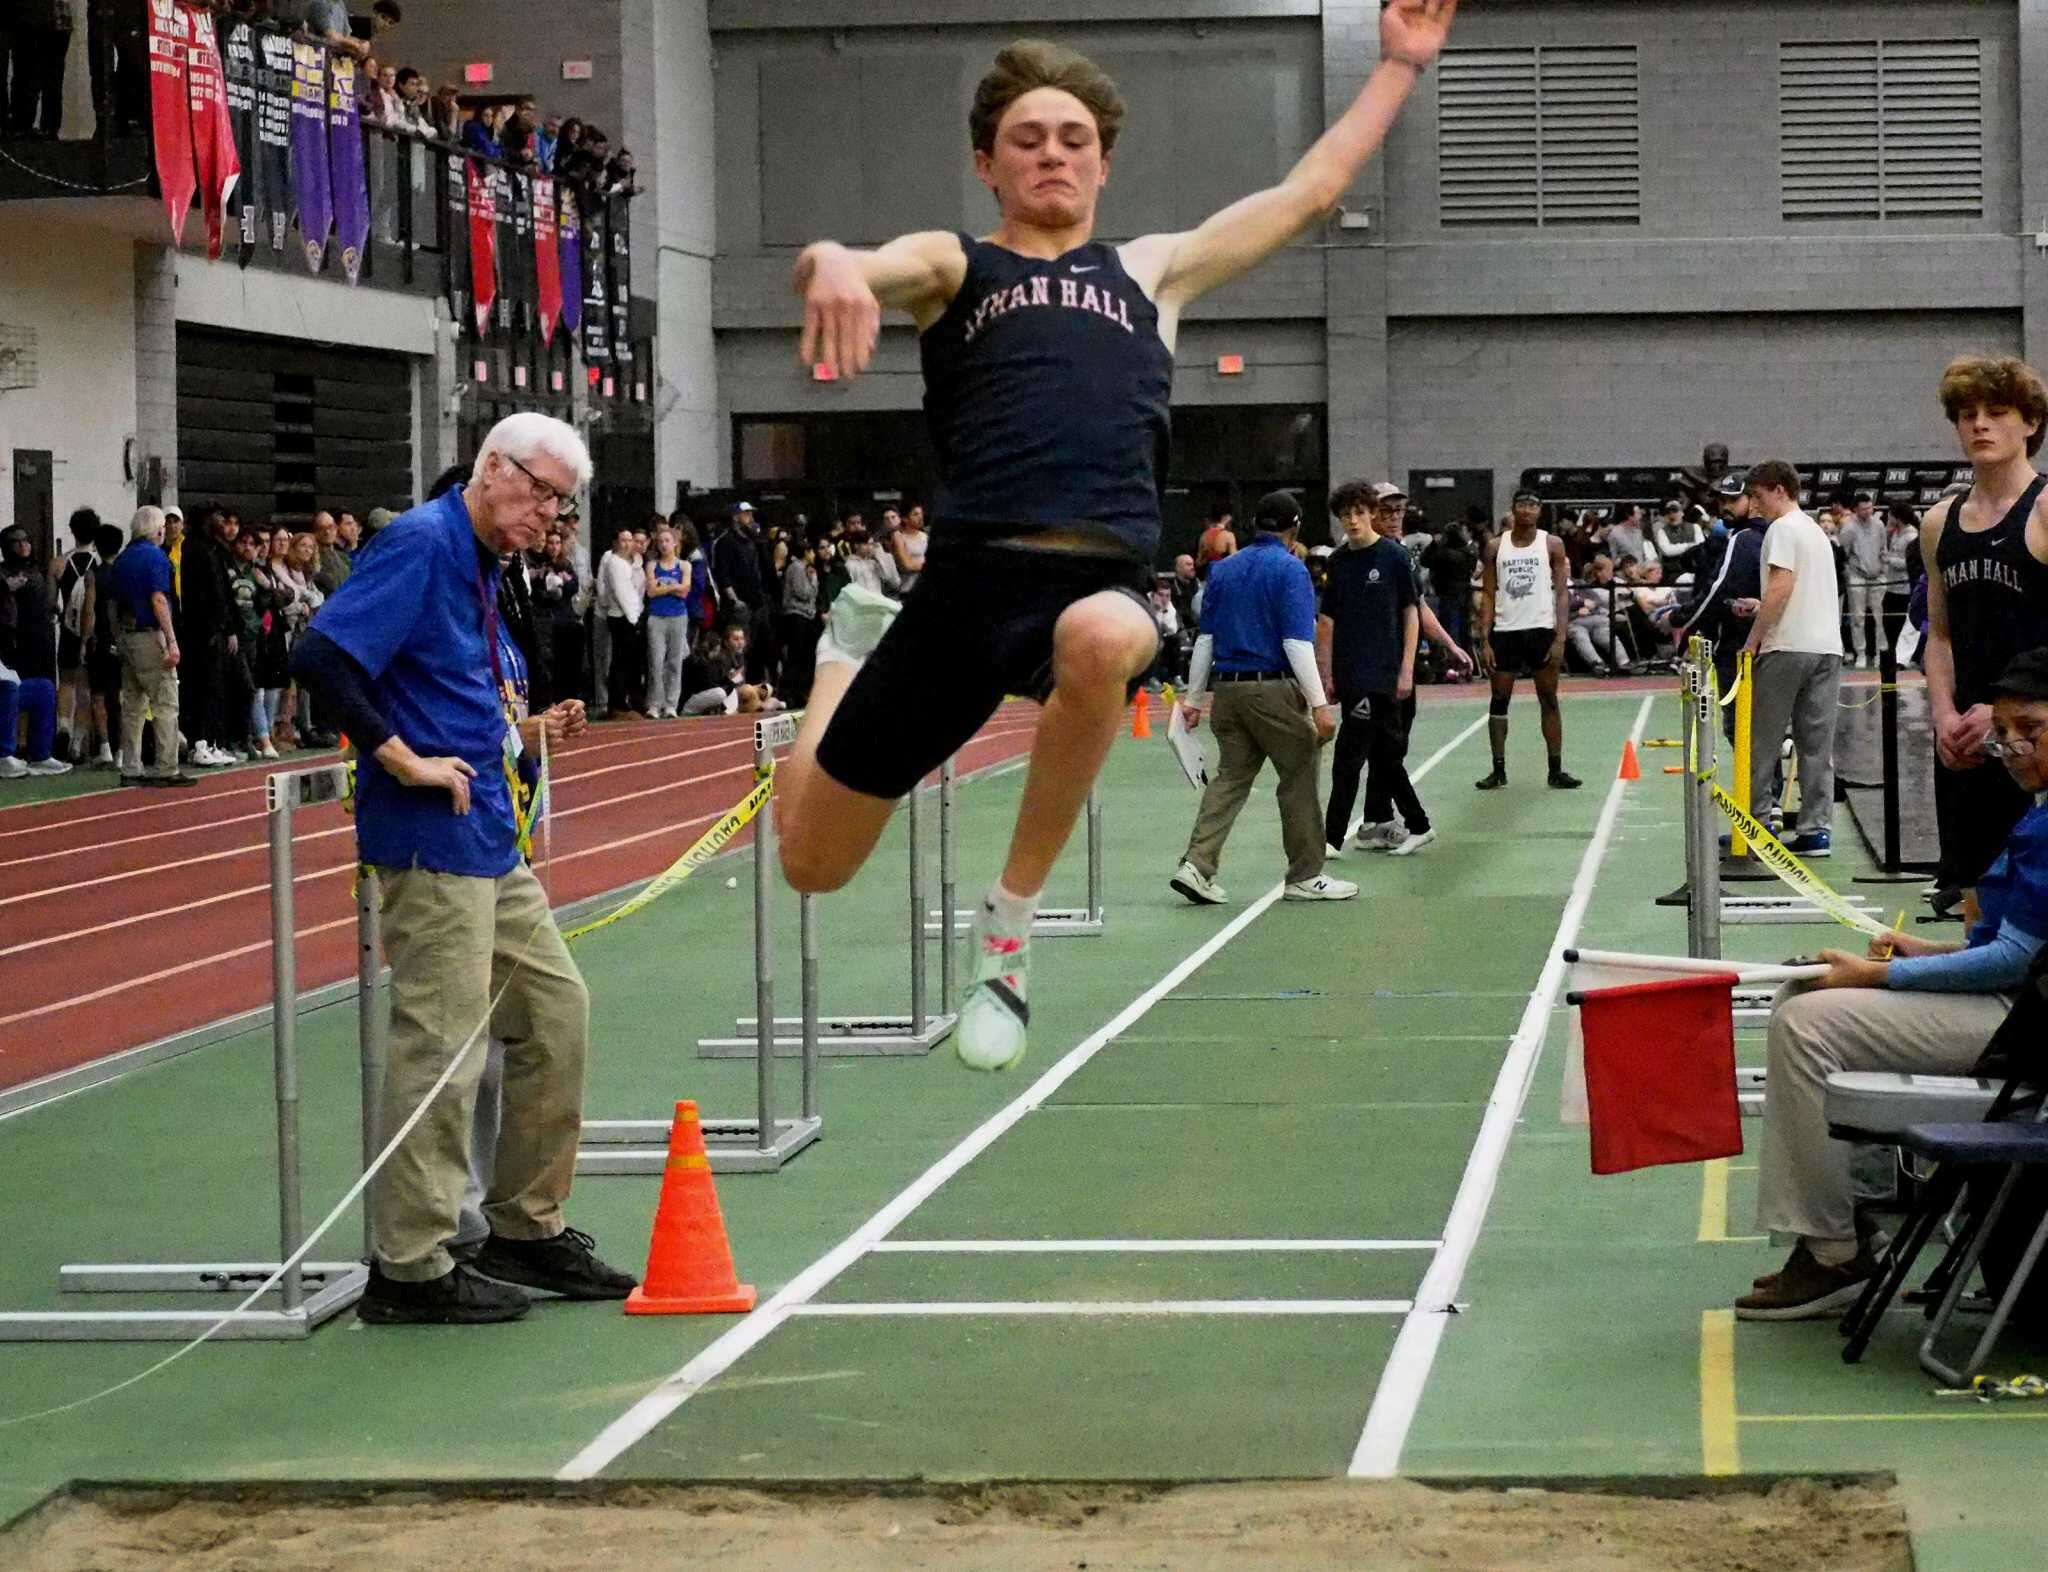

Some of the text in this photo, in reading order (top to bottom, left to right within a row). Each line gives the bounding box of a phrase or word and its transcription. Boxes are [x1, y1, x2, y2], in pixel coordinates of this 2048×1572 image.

[1060, 279, 1134, 334] HALL
[1502, 557, 1539, 567] HARTFORD
[1508, 566, 1534, 574] PUBLIC
[1984, 558, 2022, 592] HALL
